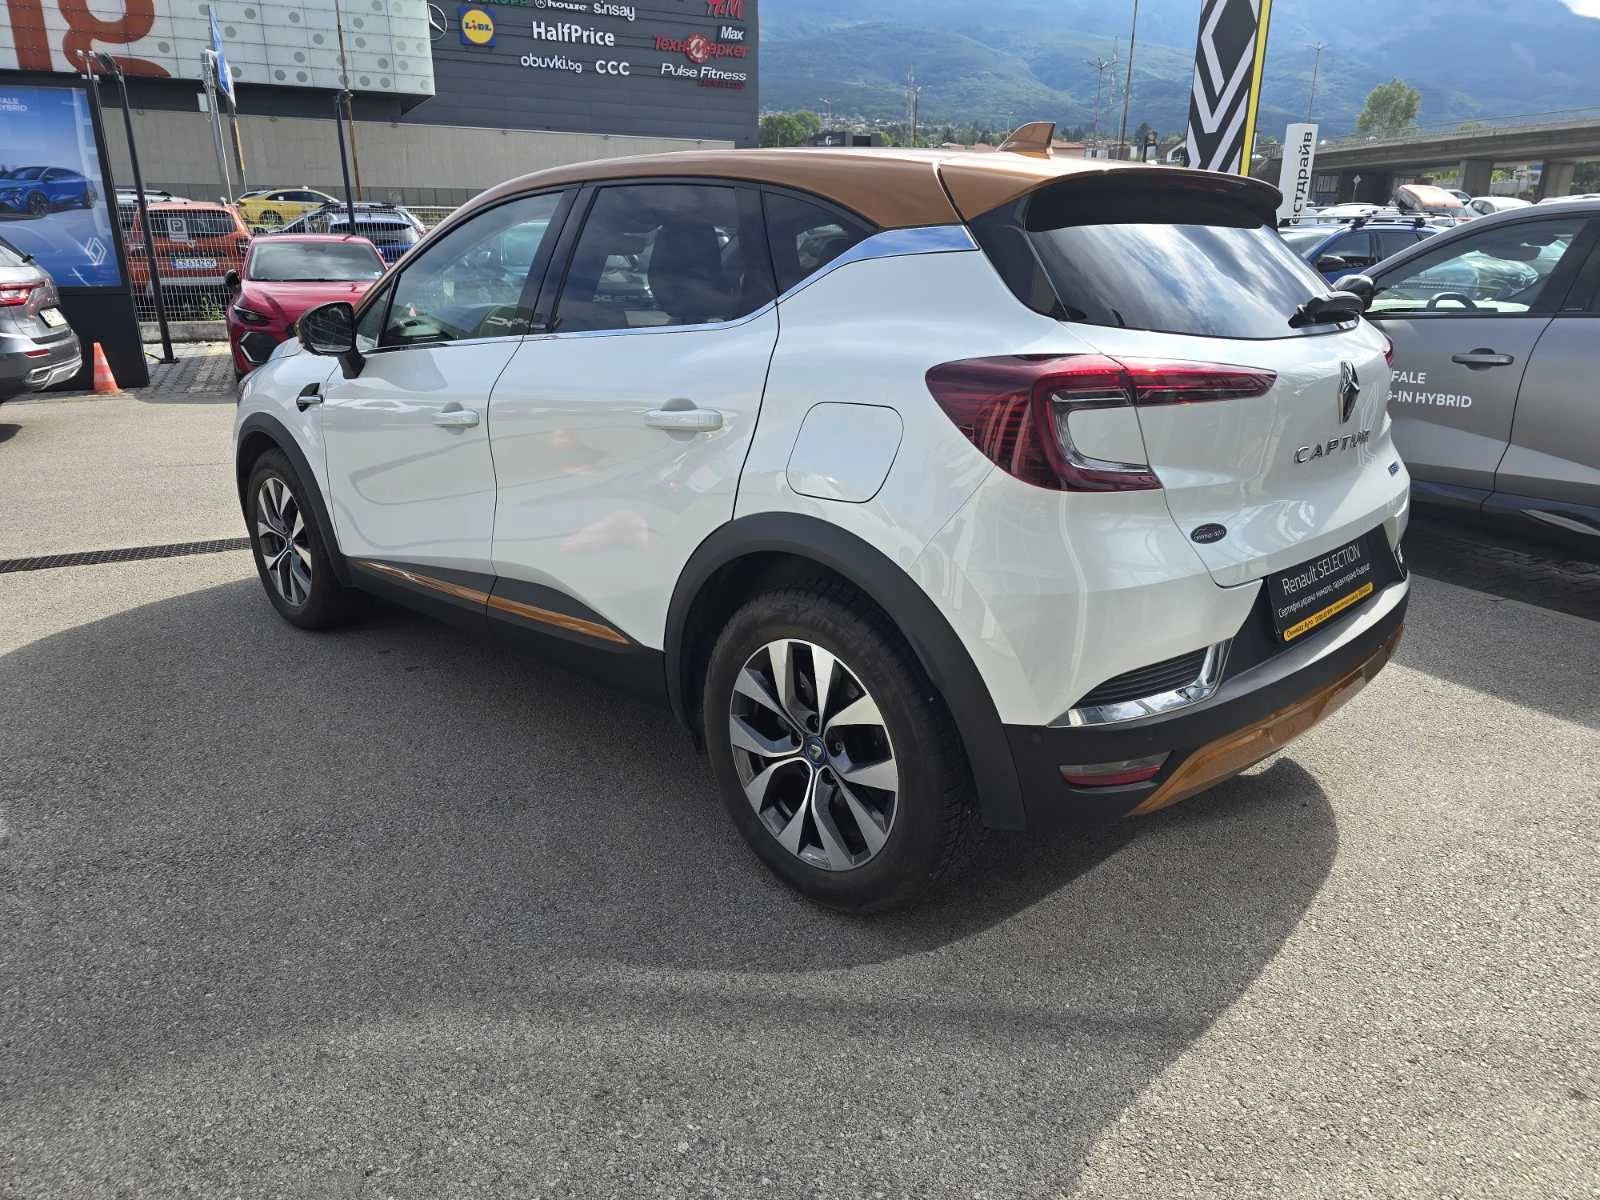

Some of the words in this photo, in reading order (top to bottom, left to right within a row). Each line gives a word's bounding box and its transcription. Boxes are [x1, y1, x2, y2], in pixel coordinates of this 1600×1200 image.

[593, 0, 636, 21] sinsay
[532, 21, 616, 46] HalfPrice
[720, 26, 745, 41] Max
[520, 52, 583, 73] obuvki.bg
[595, 59, 631, 76] CCC
[661, 62, 698, 77] Pulse
[700, 66, 748, 81] Fitness
[1415, 391, 1473, 408] HYBRID
[1294, 429, 1370, 464] CAPTUR
[1281, 565, 1318, 596] Renault
[1317, 543, 1361, 579] SELECTION
